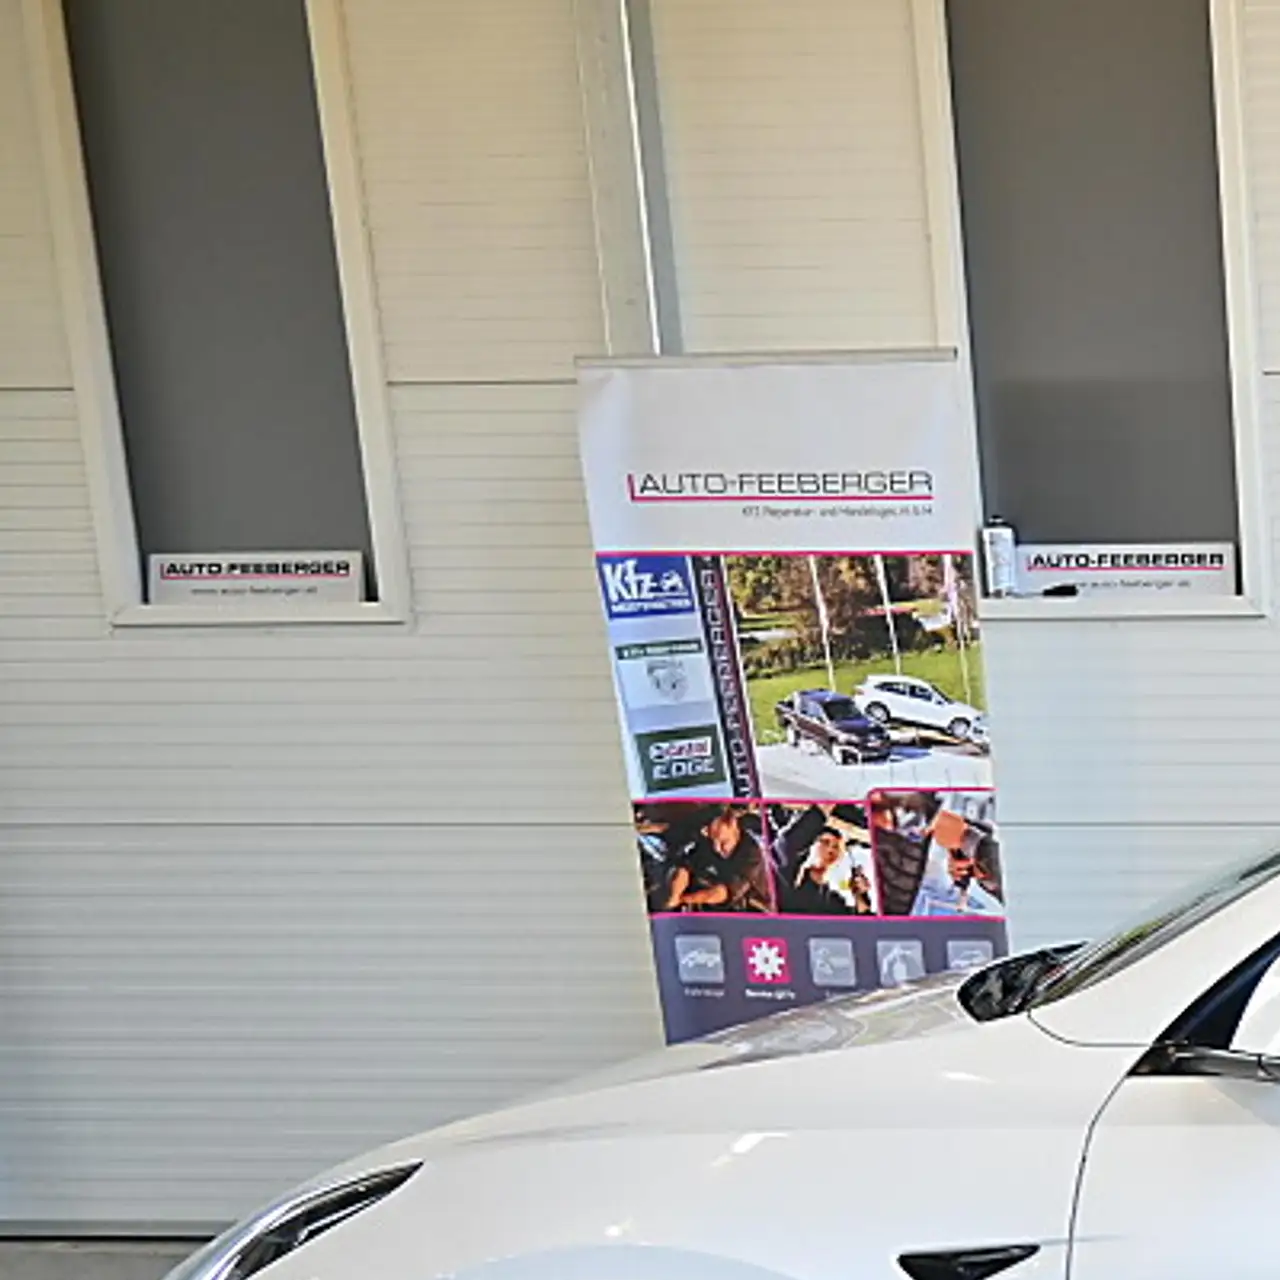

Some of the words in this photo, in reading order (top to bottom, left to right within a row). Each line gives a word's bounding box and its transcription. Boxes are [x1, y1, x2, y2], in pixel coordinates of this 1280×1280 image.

[639, 472, 933, 494] AUTO-FEEBERGER
[166, 561, 350, 576] AUTO-FEEBERGER
[1032, 553, 1225, 568] AUTO-FEEBERGER
[602, 558, 657, 602] Kfz
